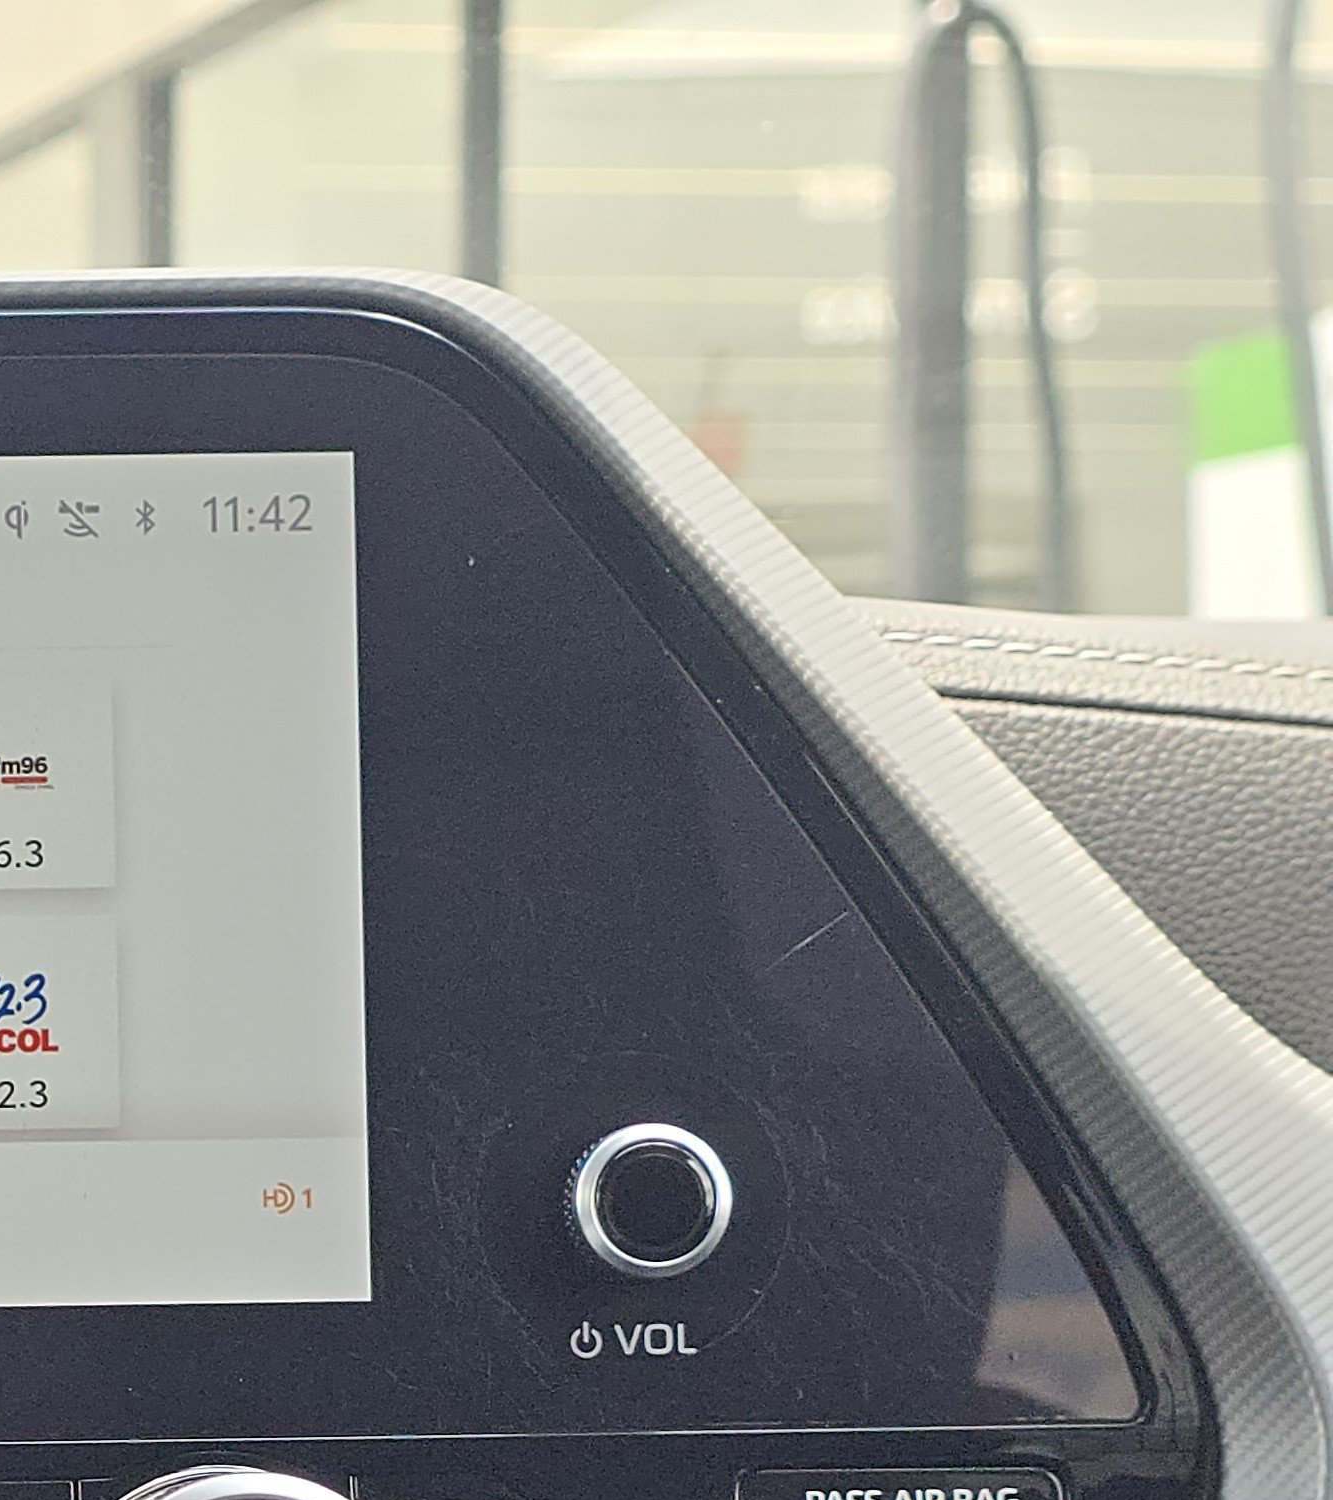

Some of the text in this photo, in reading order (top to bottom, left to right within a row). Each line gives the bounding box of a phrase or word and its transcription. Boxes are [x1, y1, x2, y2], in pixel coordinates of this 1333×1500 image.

[203, 494, 312, 532] 11:42
[301, 1187, 312, 1209] 1
[614, 1323, 698, 1355] VOL
